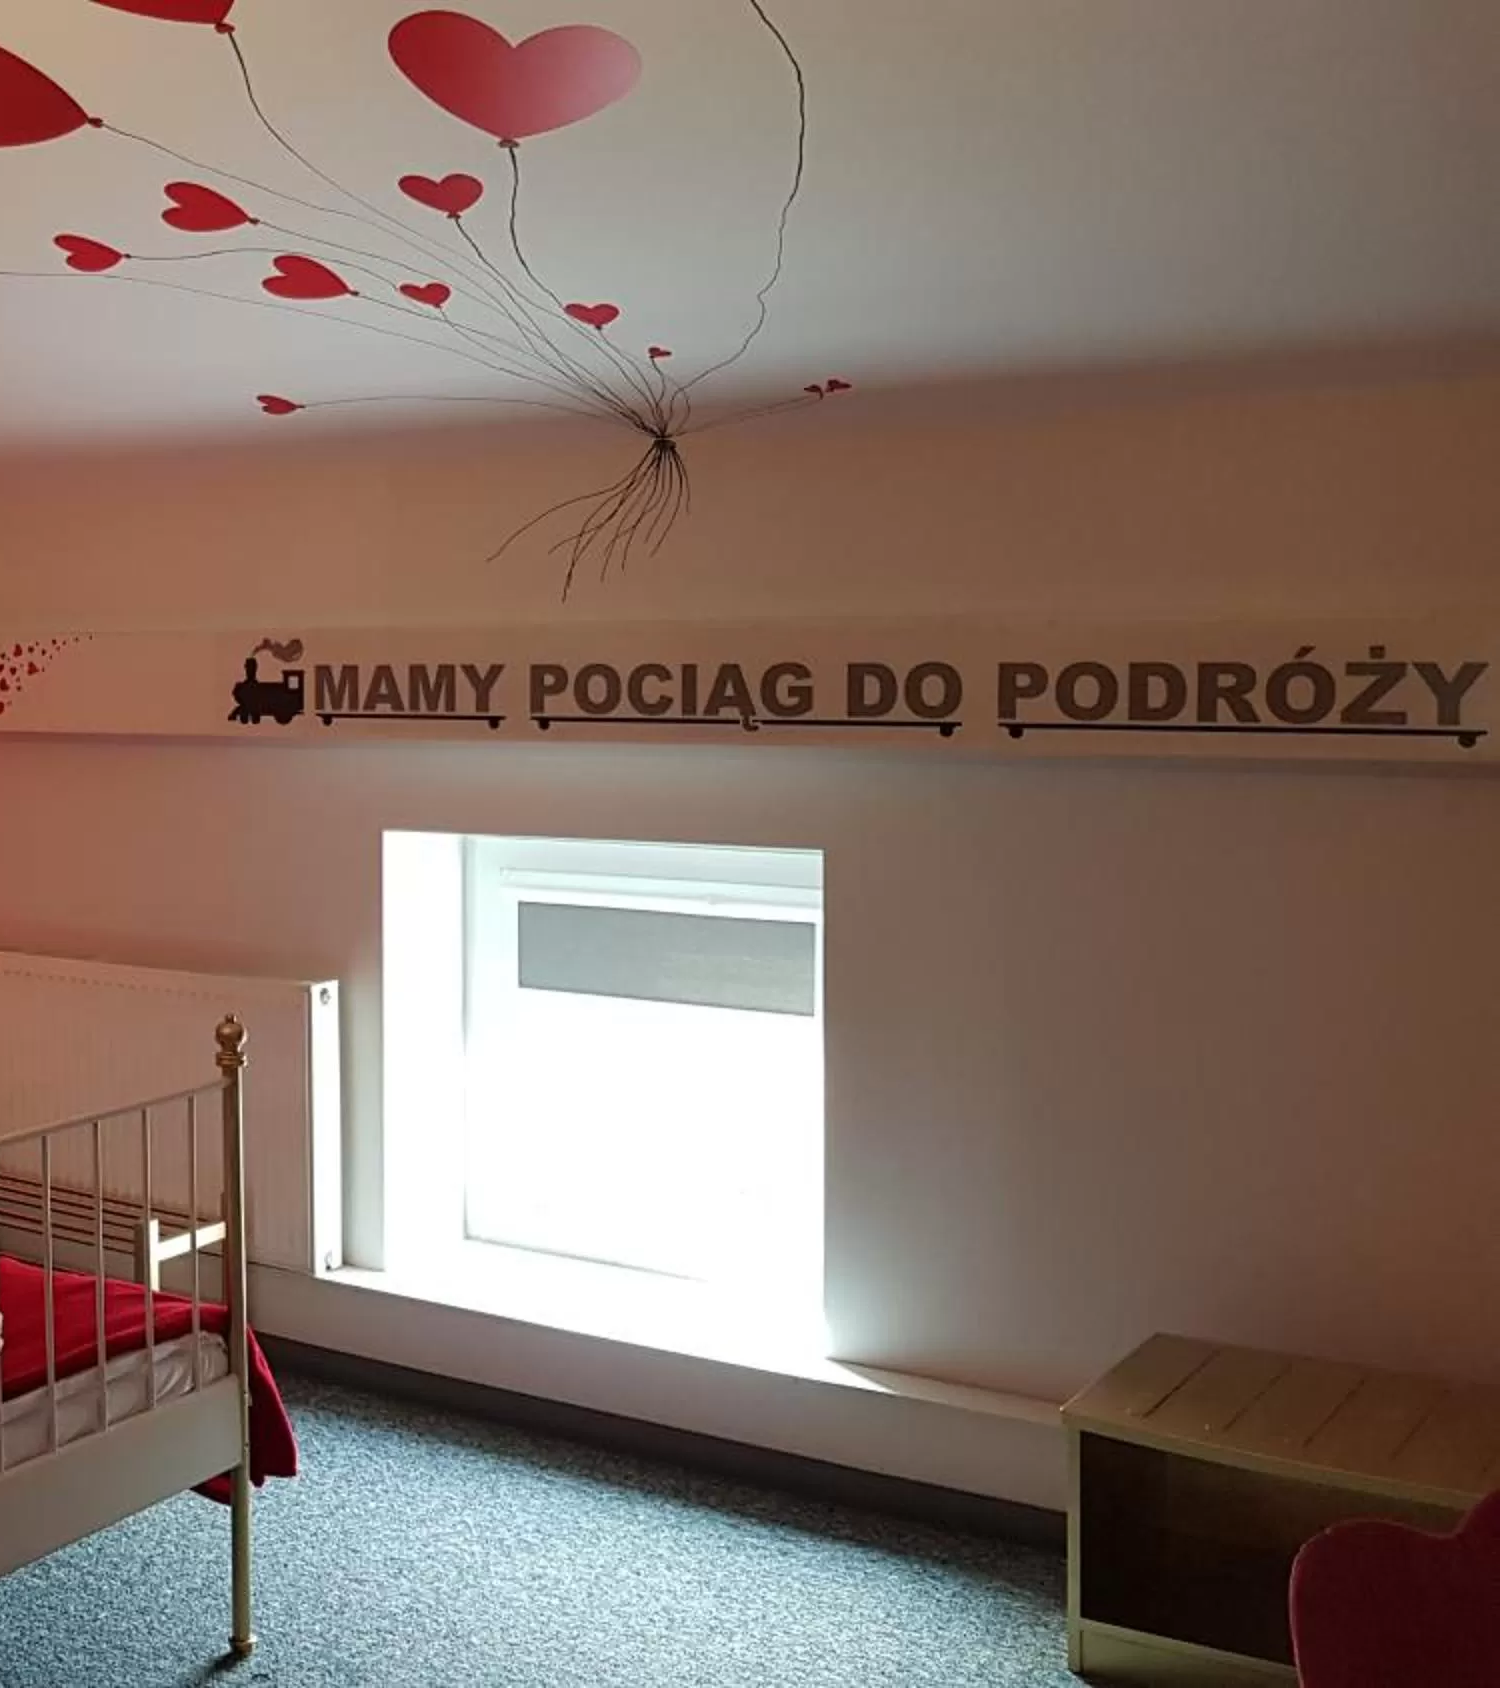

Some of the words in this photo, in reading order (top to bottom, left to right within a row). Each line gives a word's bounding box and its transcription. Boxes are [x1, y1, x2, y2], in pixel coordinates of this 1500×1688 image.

[314, 663, 505, 713] MAMY
[529, 661, 814, 732] POCIĄG
[846, 661, 963, 719] DO
[997, 645, 1490, 727] PODRÓŻY
